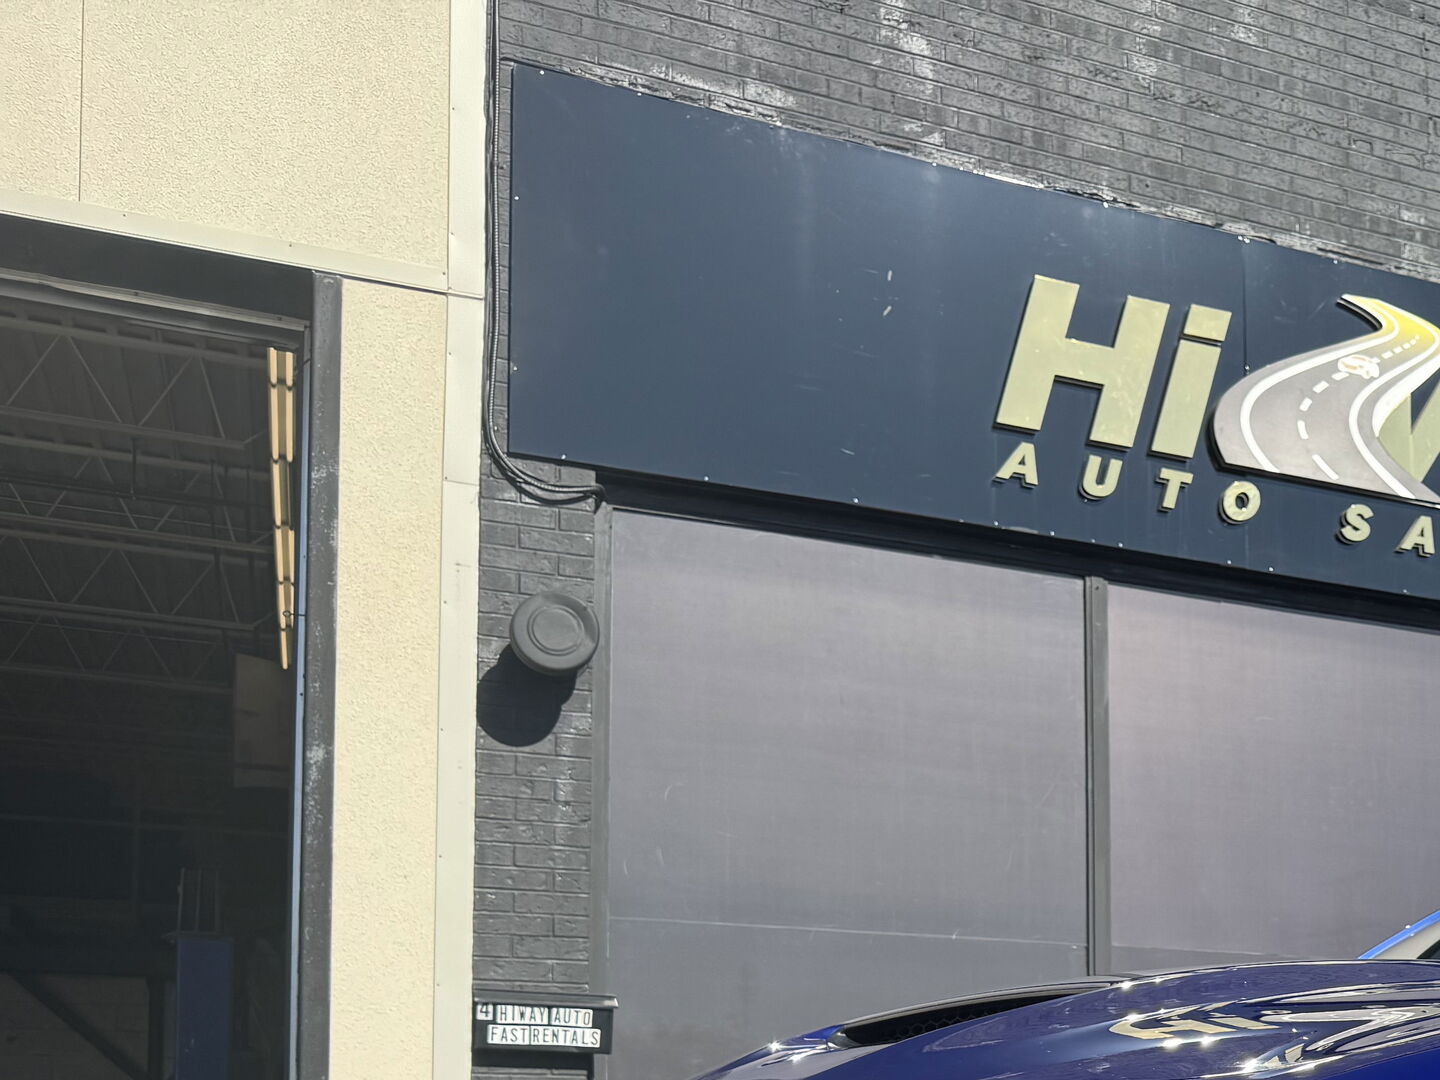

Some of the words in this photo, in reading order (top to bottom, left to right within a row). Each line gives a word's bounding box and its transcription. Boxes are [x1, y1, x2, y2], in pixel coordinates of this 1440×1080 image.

[995, 442, 1262, 525] AUTO
[479, 1003, 491, 1018] 4
[500, 1006, 547, 1023] HIWAY
[553, 1009, 591, 1026] AUTO
